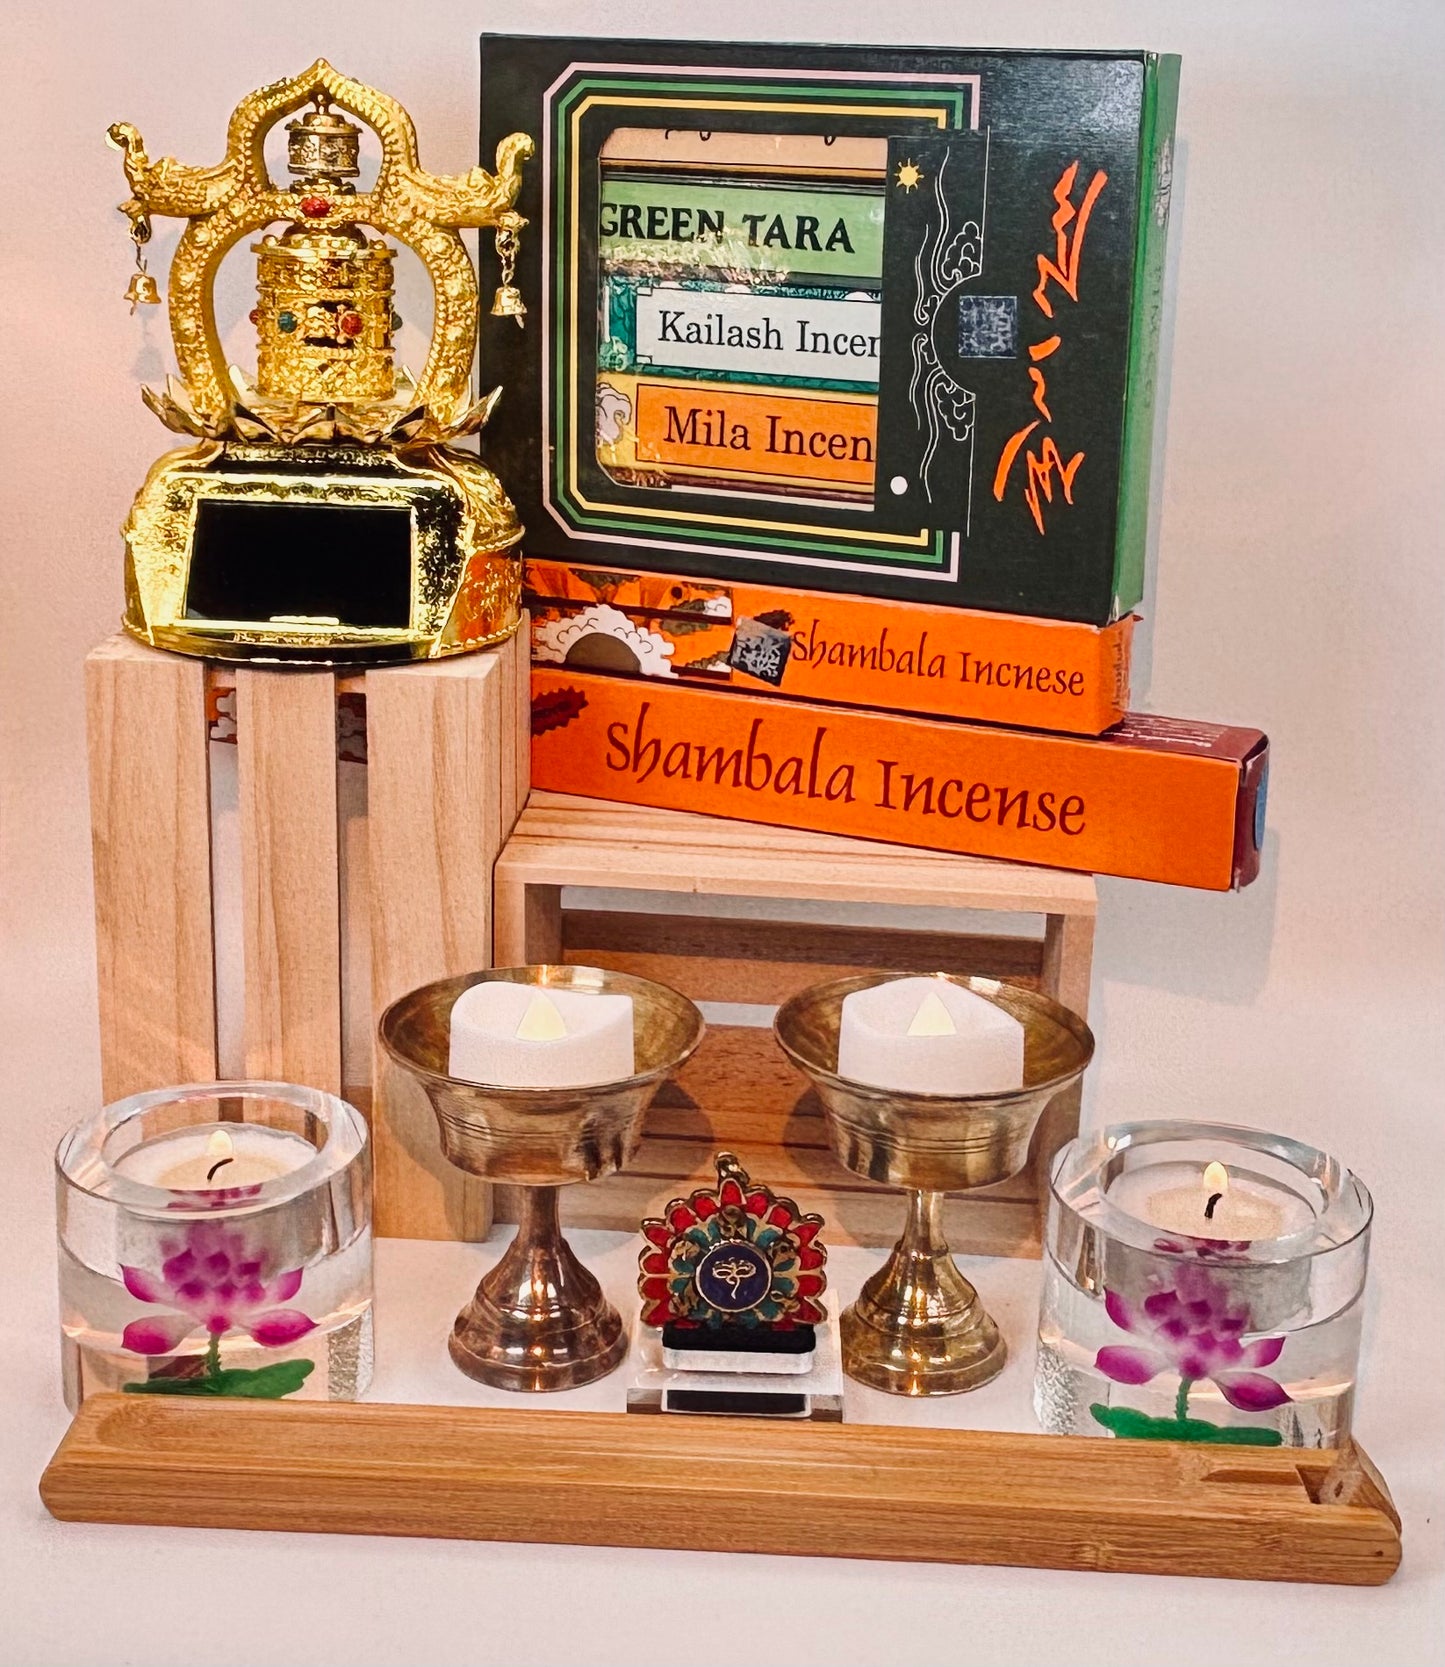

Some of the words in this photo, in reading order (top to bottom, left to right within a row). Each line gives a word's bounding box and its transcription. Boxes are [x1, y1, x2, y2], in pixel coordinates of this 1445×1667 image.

[600, 202, 725, 244] GREEN
[742, 213, 856, 254] TARA
[658, 310, 784, 351] Kailash
[663, 406, 752, 452] Mila
[766, 415, 875, 463] Incen
[959, 652, 1085, 697] Incnese
[874, 759, 1087, 837] Incense
